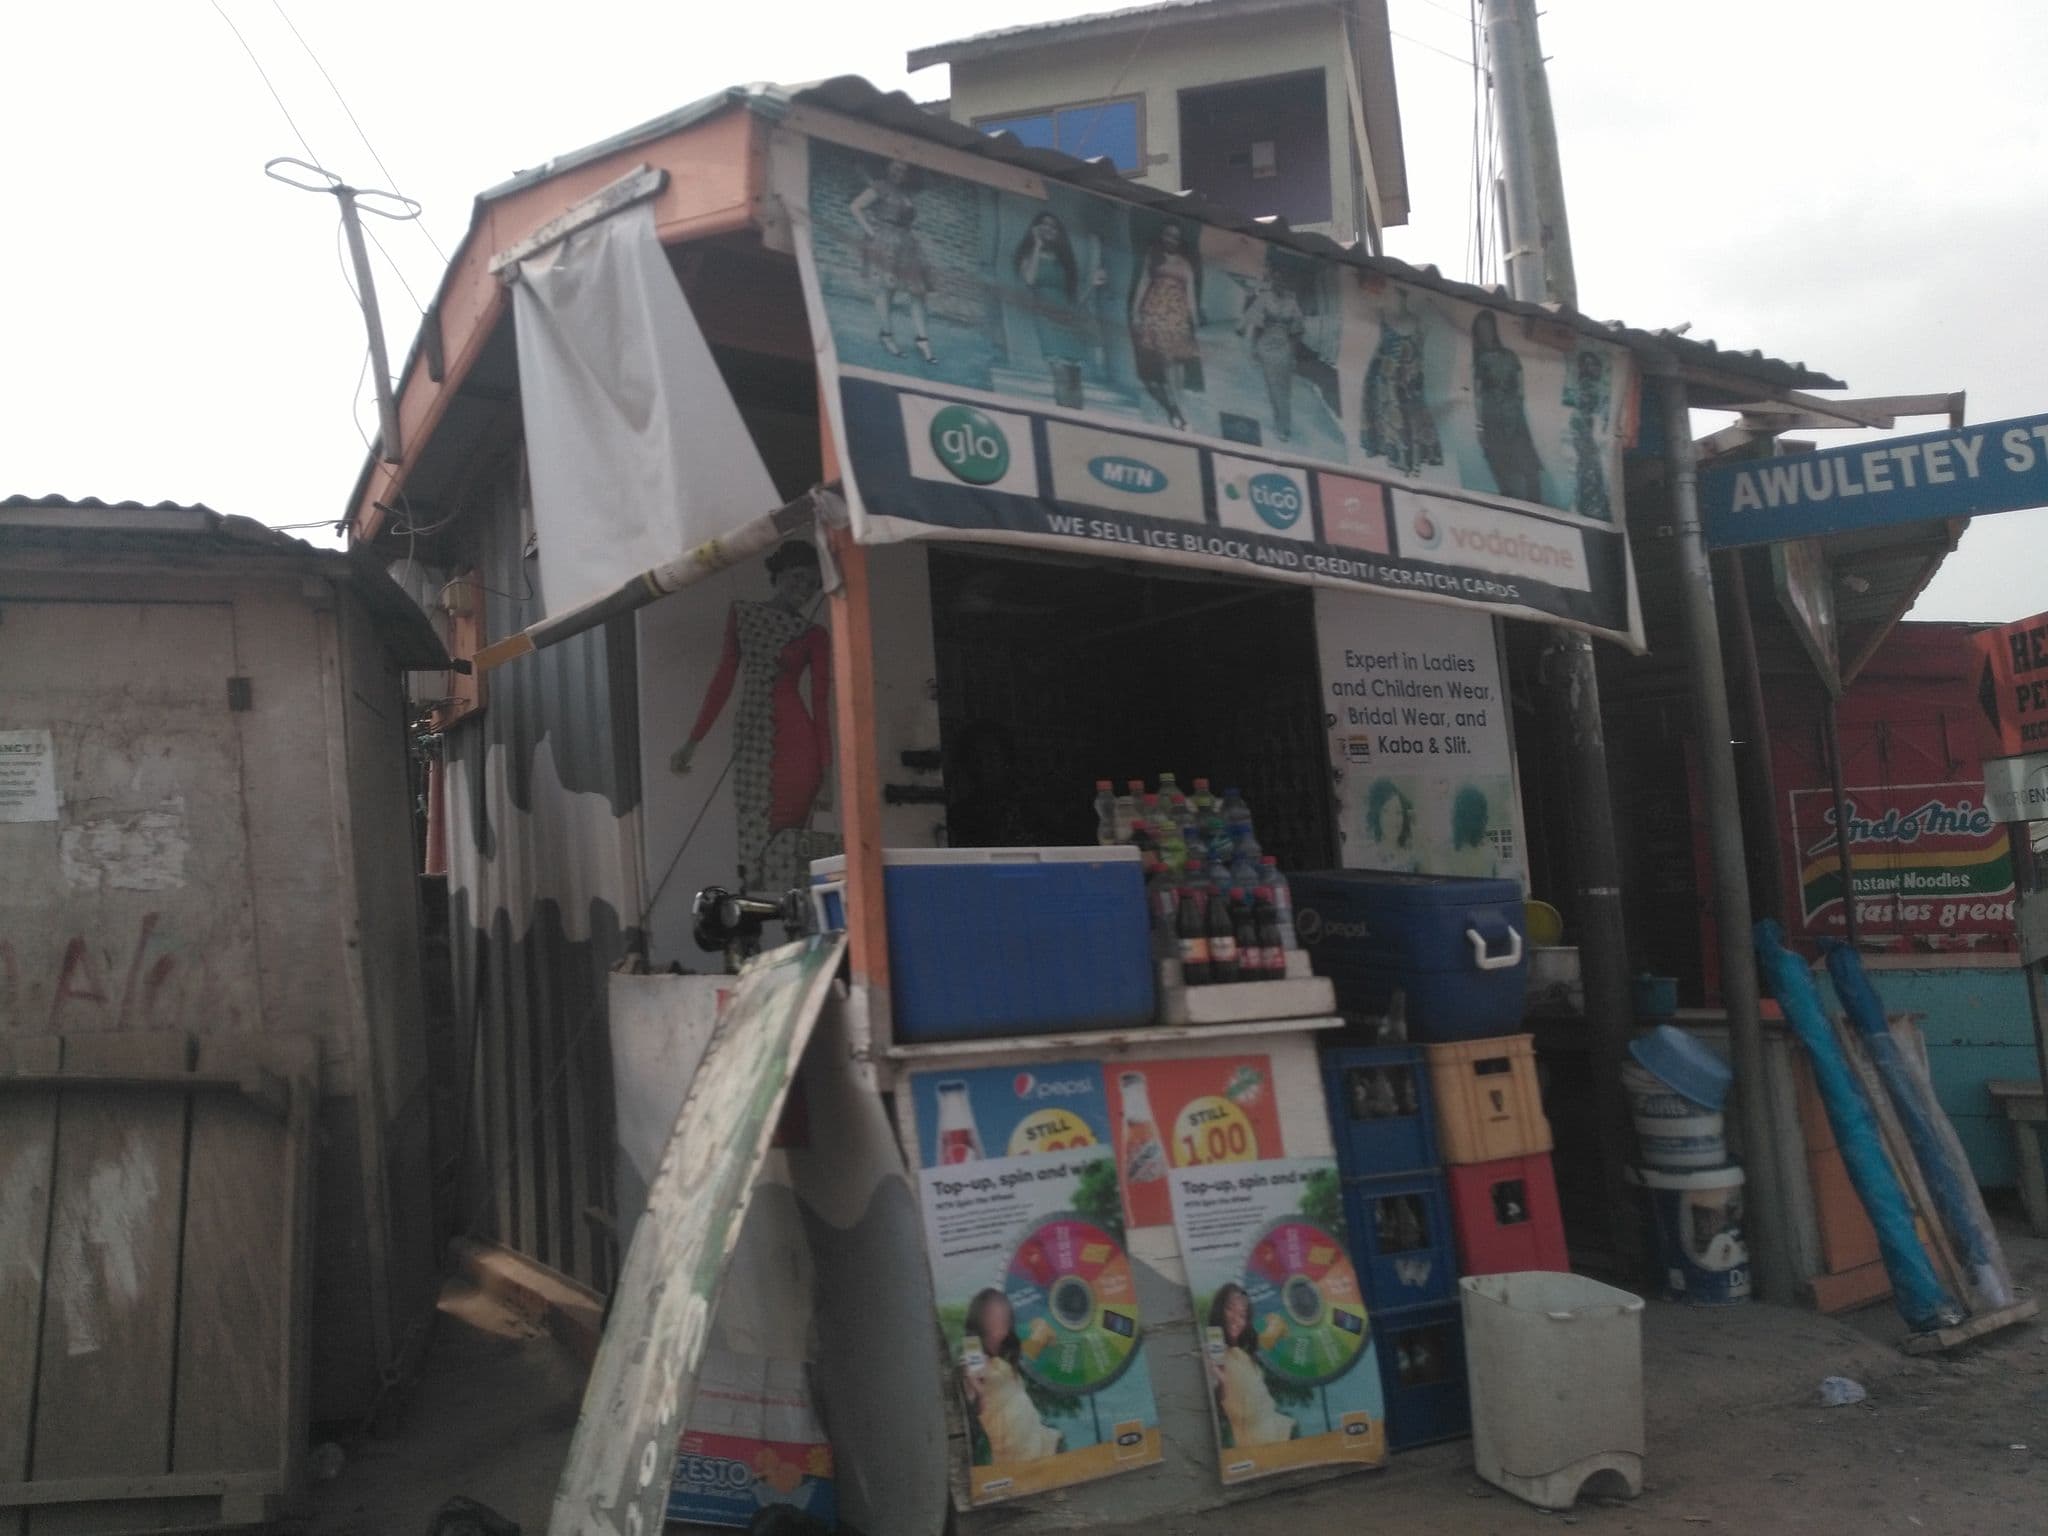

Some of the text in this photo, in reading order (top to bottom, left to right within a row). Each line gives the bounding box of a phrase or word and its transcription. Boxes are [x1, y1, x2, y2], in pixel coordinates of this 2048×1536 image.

[941, 424, 999, 464] glo
[1101, 460, 1155, 488] MTN
[1732, 434, 1984, 513] AWULETEY
[1046, 514, 1086, 536] WE
[1089, 520, 1142, 544] SELL
[1143, 529, 1180, 549] ICE
[1182, 534, 1252, 560] BLOCK
[1255, 546, 1298, 567] AND
[1378, 566, 1461, 592] SCRATCH
[1462, 577, 1521, 599] CARDS
[1450, 526, 1576, 570] vodafone
[1344, 650, 1476, 673] Expert in Ladies
[1332, 679, 1496, 702] and Children Wear,
[1347, 707, 1488, 729] Bridal Wear, and
[1377, 735, 1424, 754] Kaba
[1428, 737, 1443, 754] &
[1852, 872, 1971, 892] nstant Noodles
[1037, 1078, 1094, 1099] pepsi
[1188, 1105, 1229, 1127] STILL
[1025, 1117, 1073, 1141] STILL
[1182, 1122, 1247, 1166] 1.00
[932, 1177, 997, 1196] Top-up,
[999, 1168, 1034, 1188] spin
[1037, 1164, 1067, 1180] and
[1181, 1180, 1237, 1196] Top-up,
[1238, 1173, 1267, 1191] spin
[1270, 1169, 1296, 1185] and
